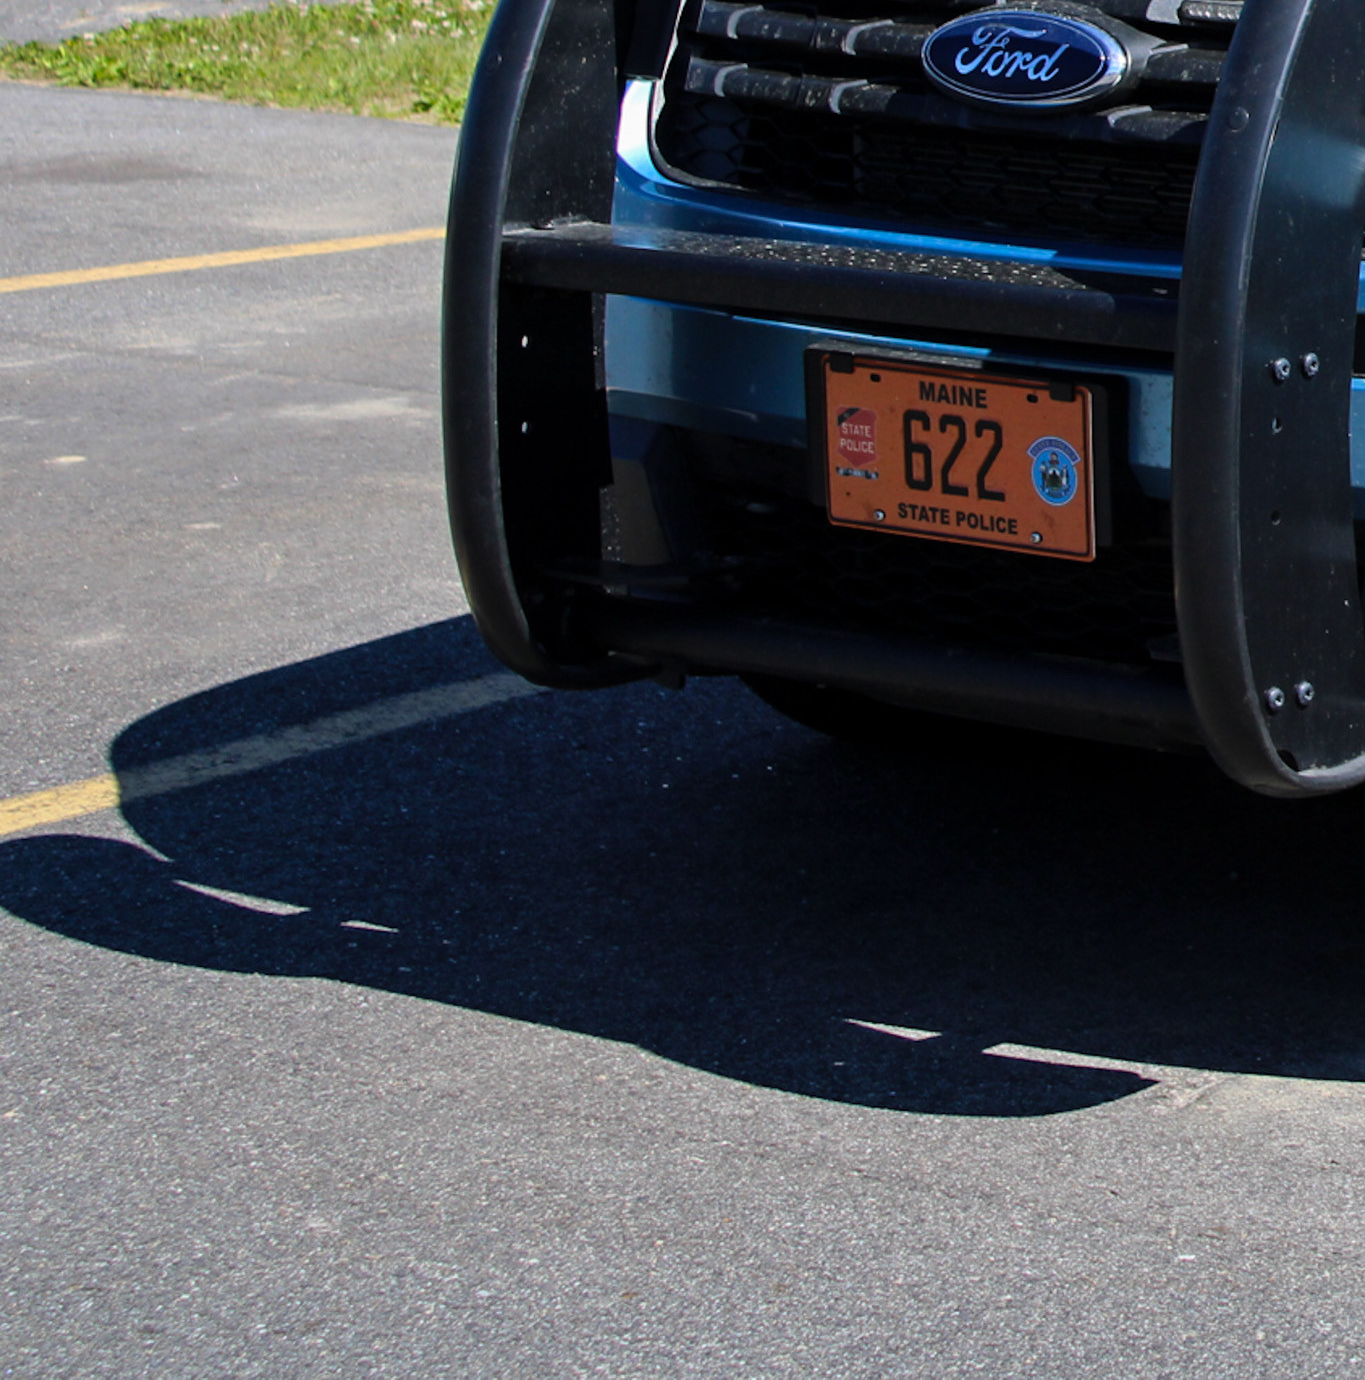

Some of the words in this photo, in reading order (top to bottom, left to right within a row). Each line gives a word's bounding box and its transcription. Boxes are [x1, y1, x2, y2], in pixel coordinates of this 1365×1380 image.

[954, 23, 1068, 82] Ford
[919, 381, 988, 409] MAINE
[841, 422, 871, 437] STATE
[840, 438, 874, 454] POLICE
[903, 409, 1006, 502] 622
[898, 502, 950, 526] STATE
[956, 511, 1018, 535] POLICE
